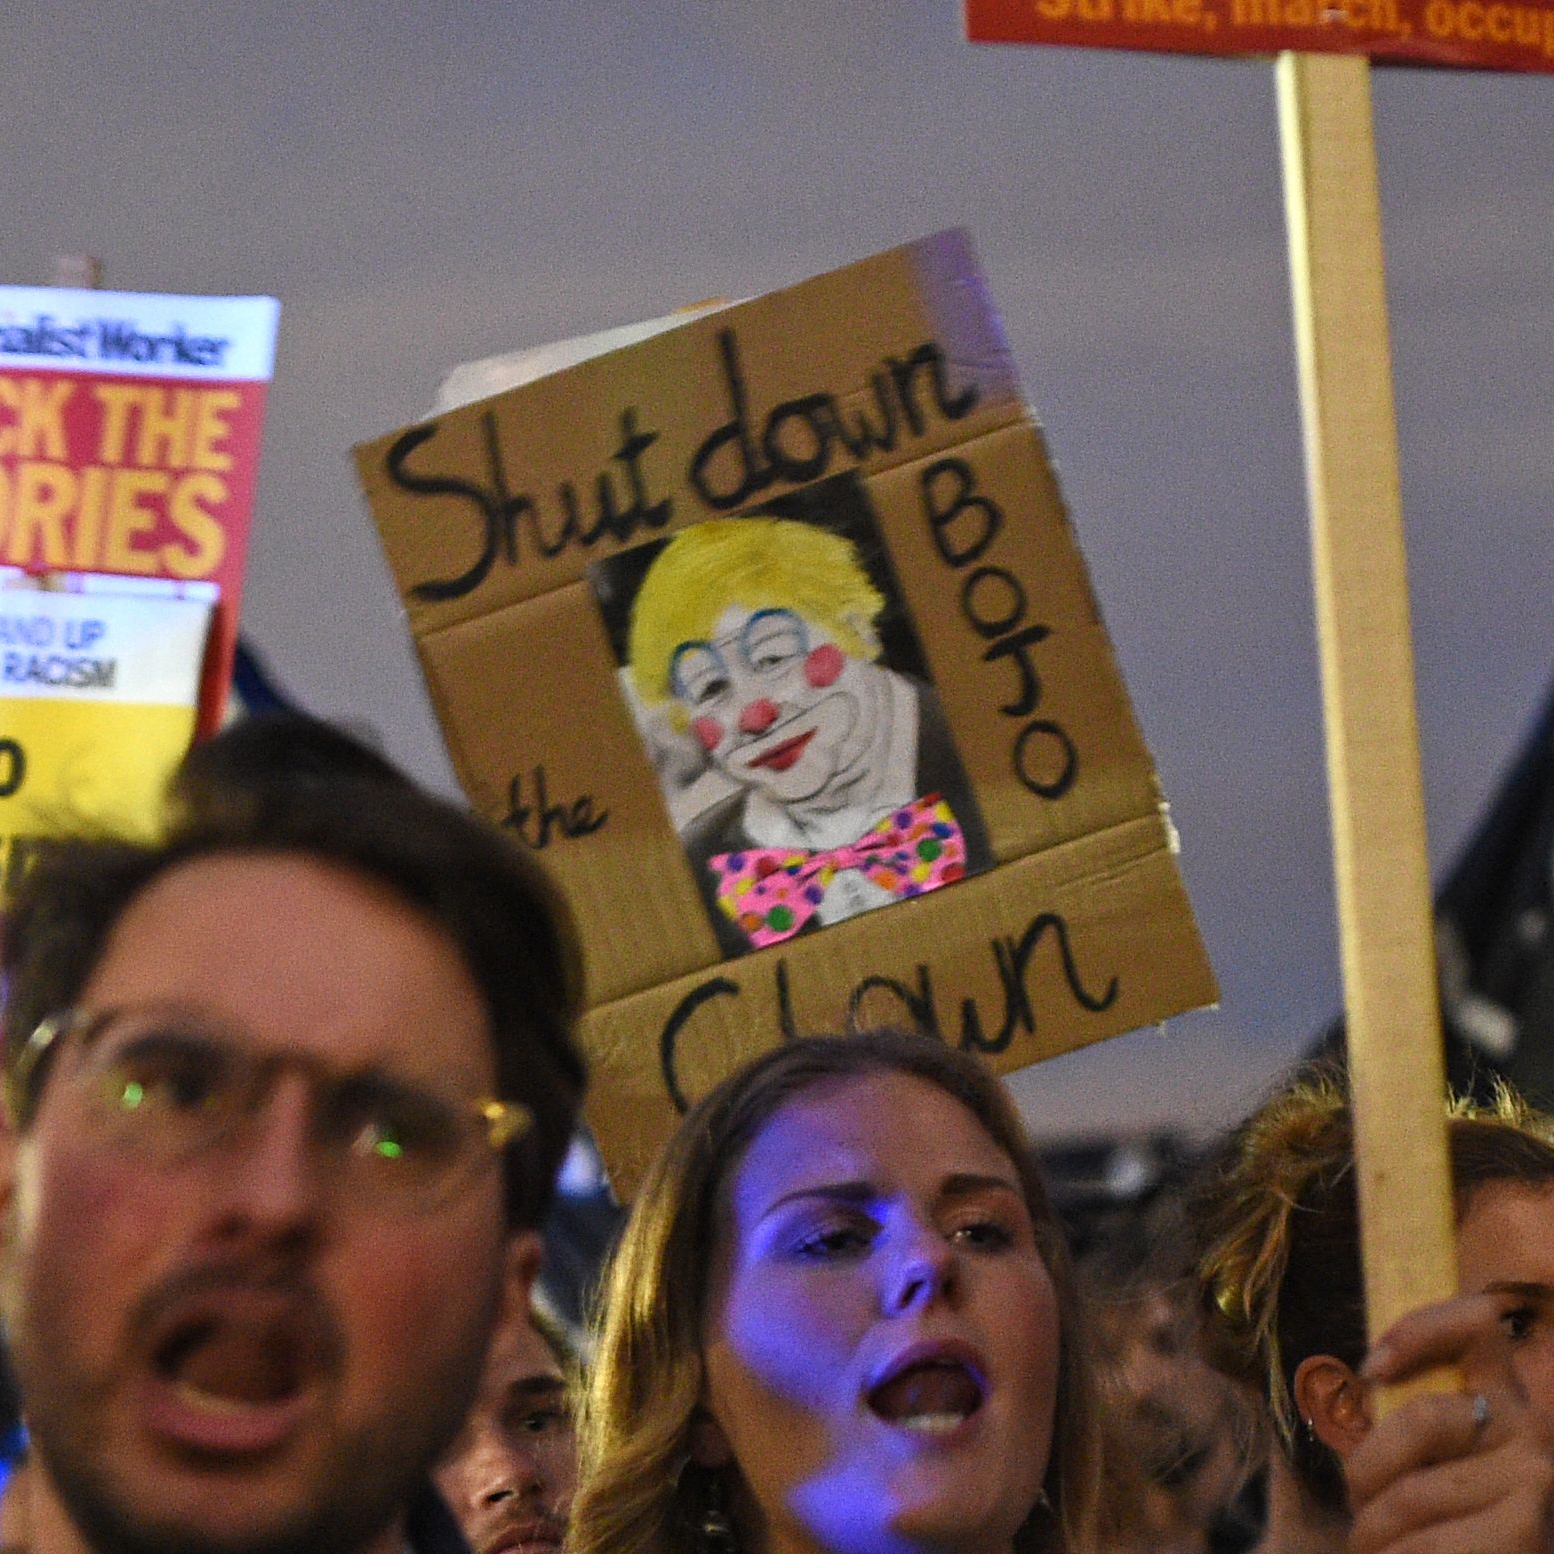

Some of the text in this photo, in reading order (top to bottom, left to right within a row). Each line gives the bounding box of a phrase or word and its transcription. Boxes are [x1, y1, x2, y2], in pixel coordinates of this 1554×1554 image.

[97, 317, 231, 368] Worker
[92, 384, 244, 472] THE
[387, 327, 984, 600] Shut down
[502, 764, 610, 853] the
